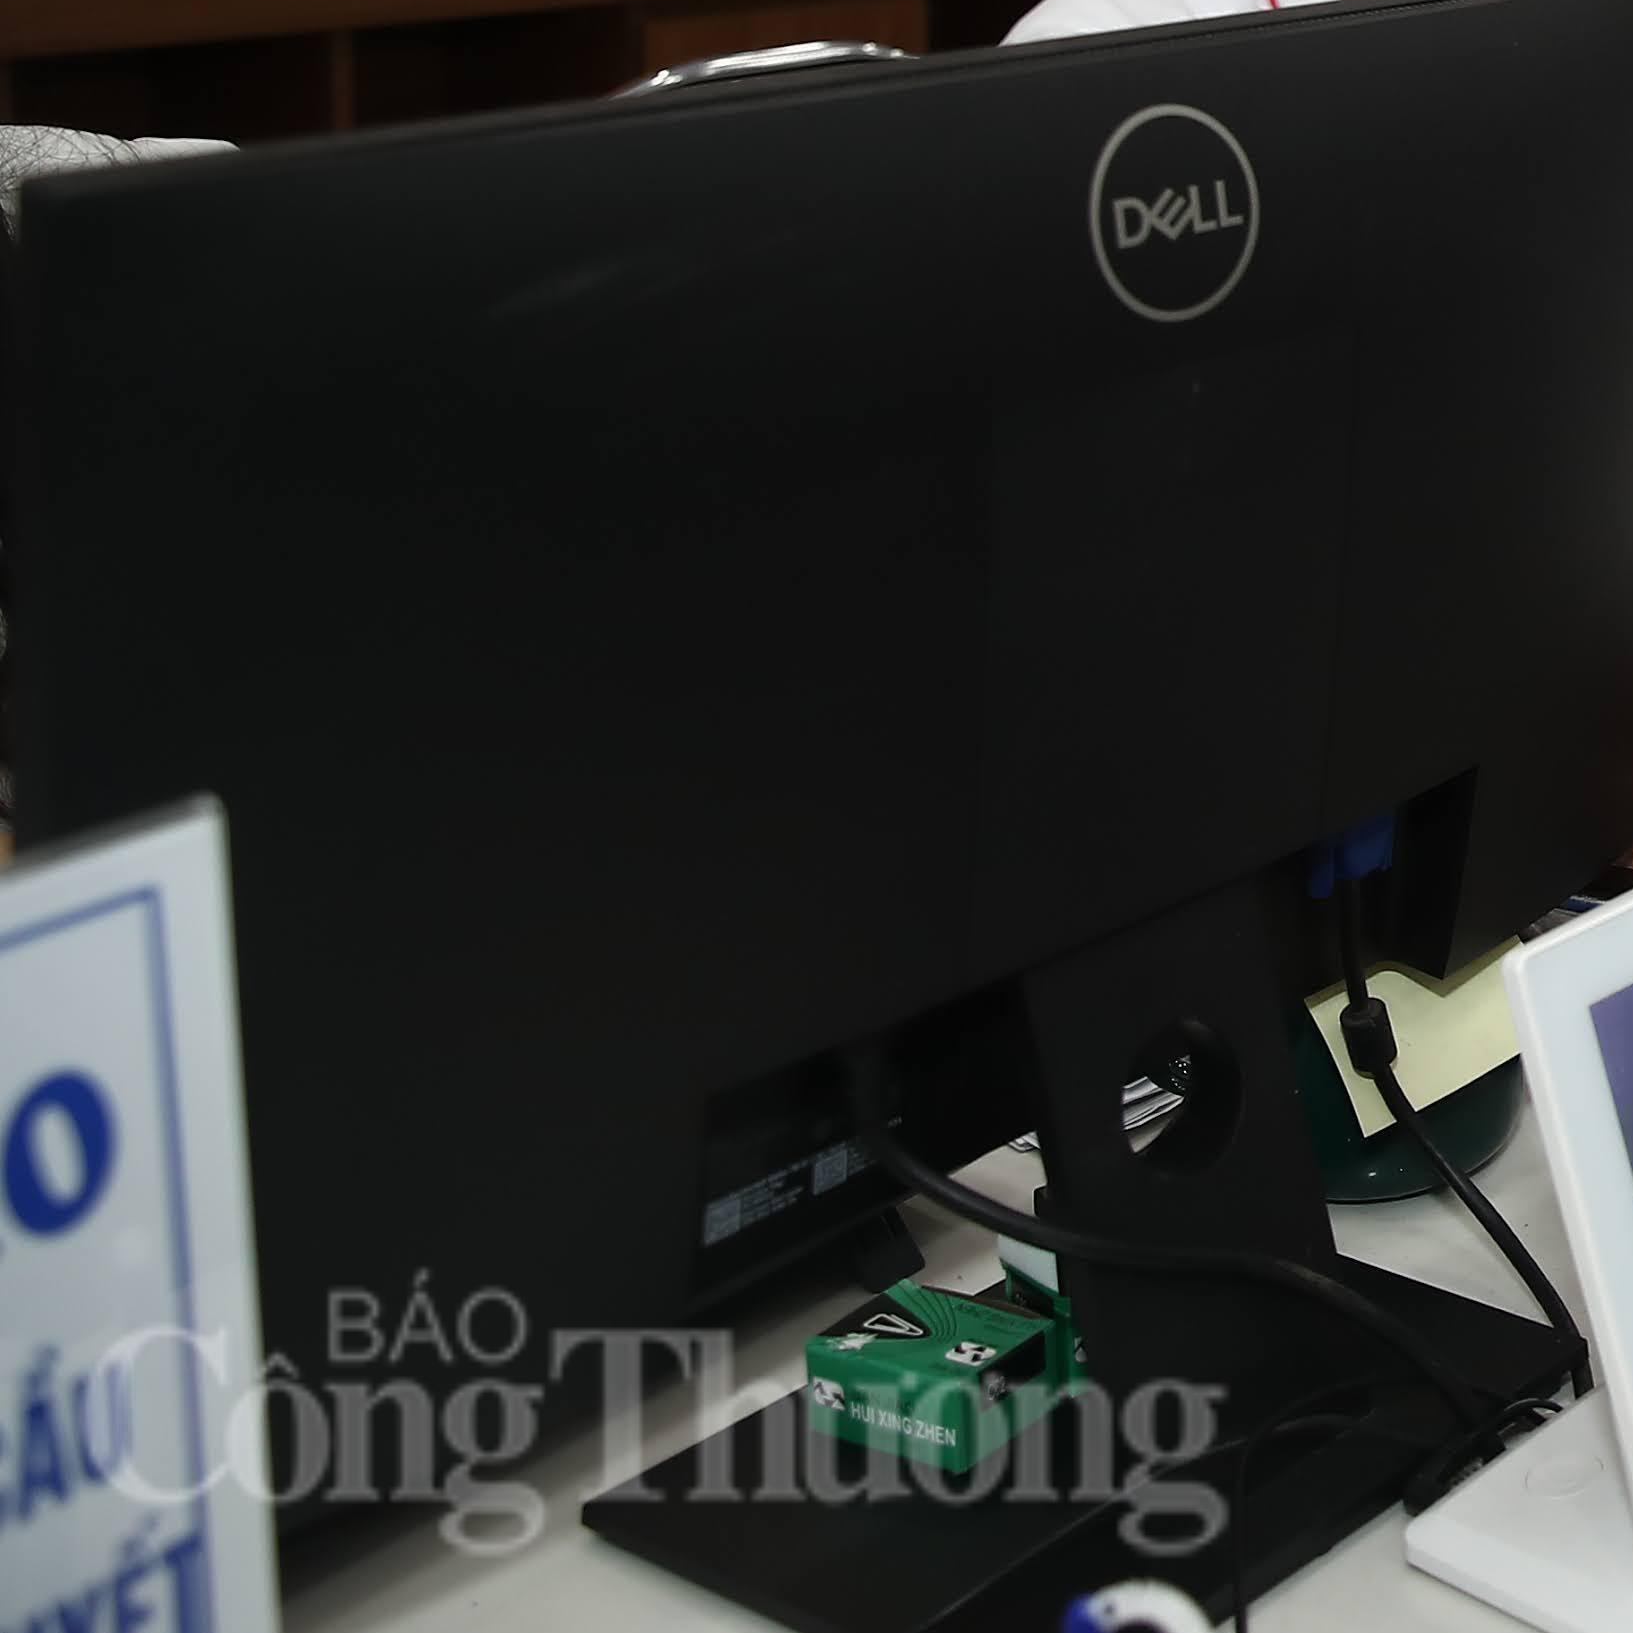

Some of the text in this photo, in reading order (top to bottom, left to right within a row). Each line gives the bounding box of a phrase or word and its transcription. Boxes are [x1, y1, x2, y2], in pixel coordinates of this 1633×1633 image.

[1113, 180, 1244, 248] DELL
[851, 1402, 956, 1447] HUI XING ZHEN
